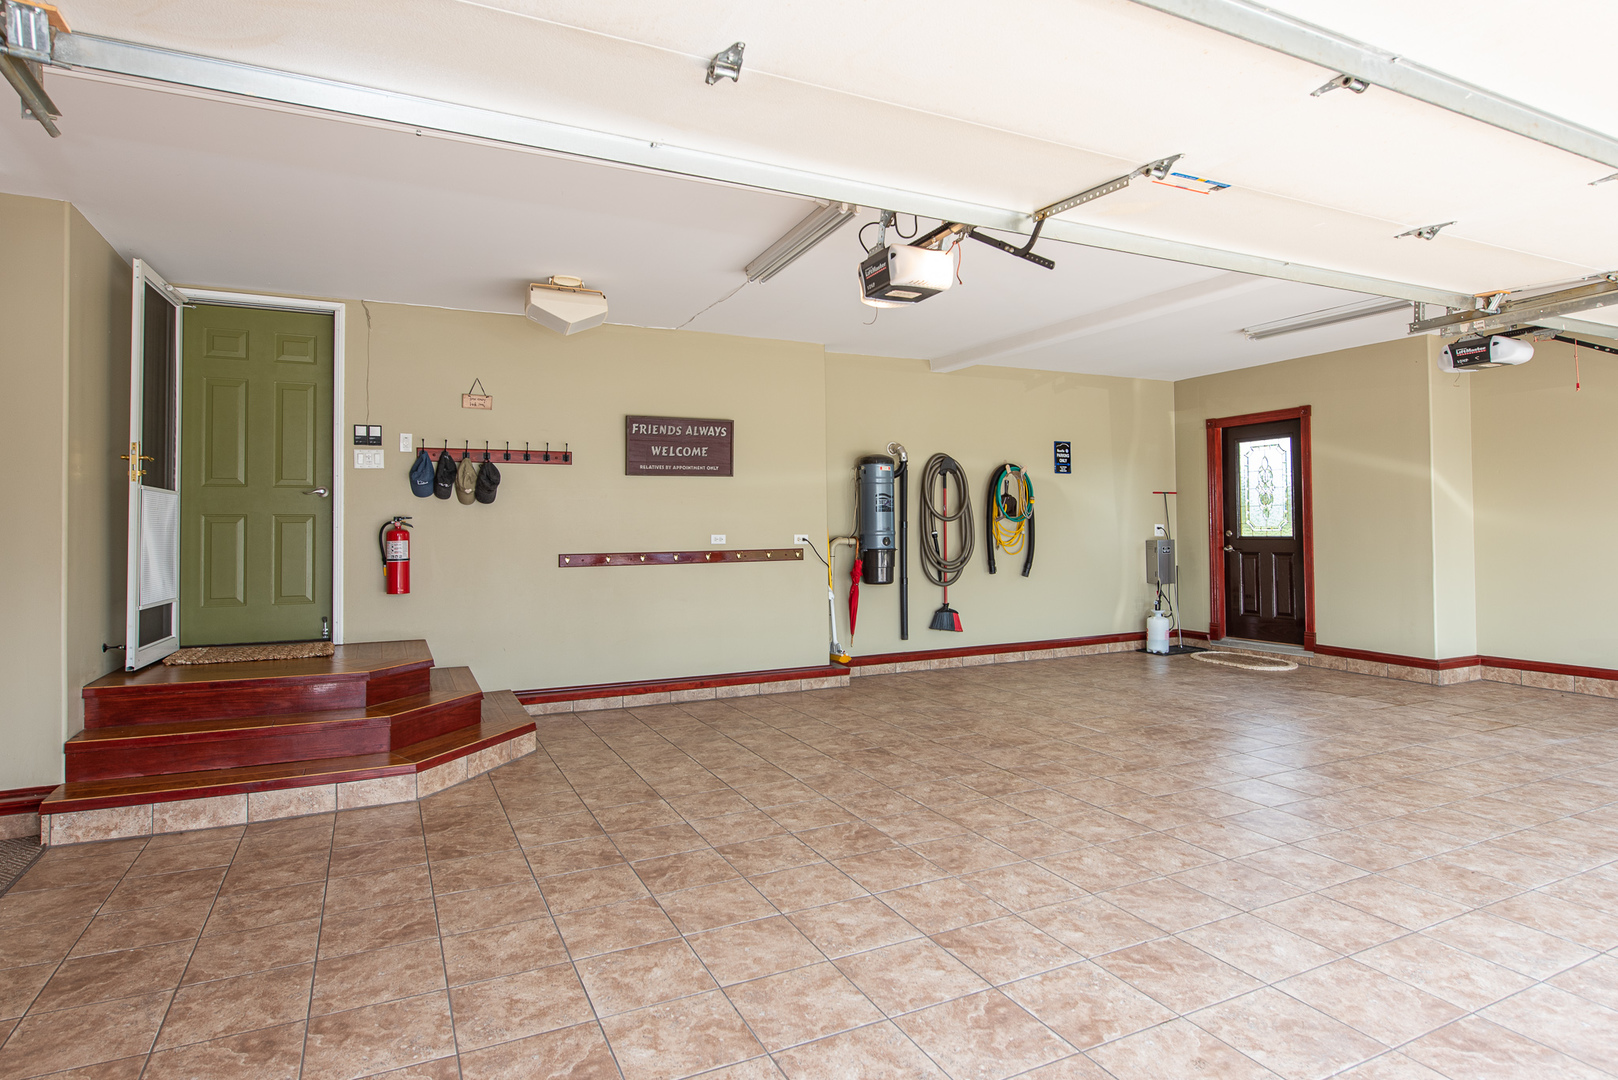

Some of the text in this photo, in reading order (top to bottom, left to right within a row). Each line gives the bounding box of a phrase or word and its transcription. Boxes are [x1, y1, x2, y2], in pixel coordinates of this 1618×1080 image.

[632, 423, 727, 437] FRIENDS ALWAYS
[651, 445, 709, 457] WELCOME
